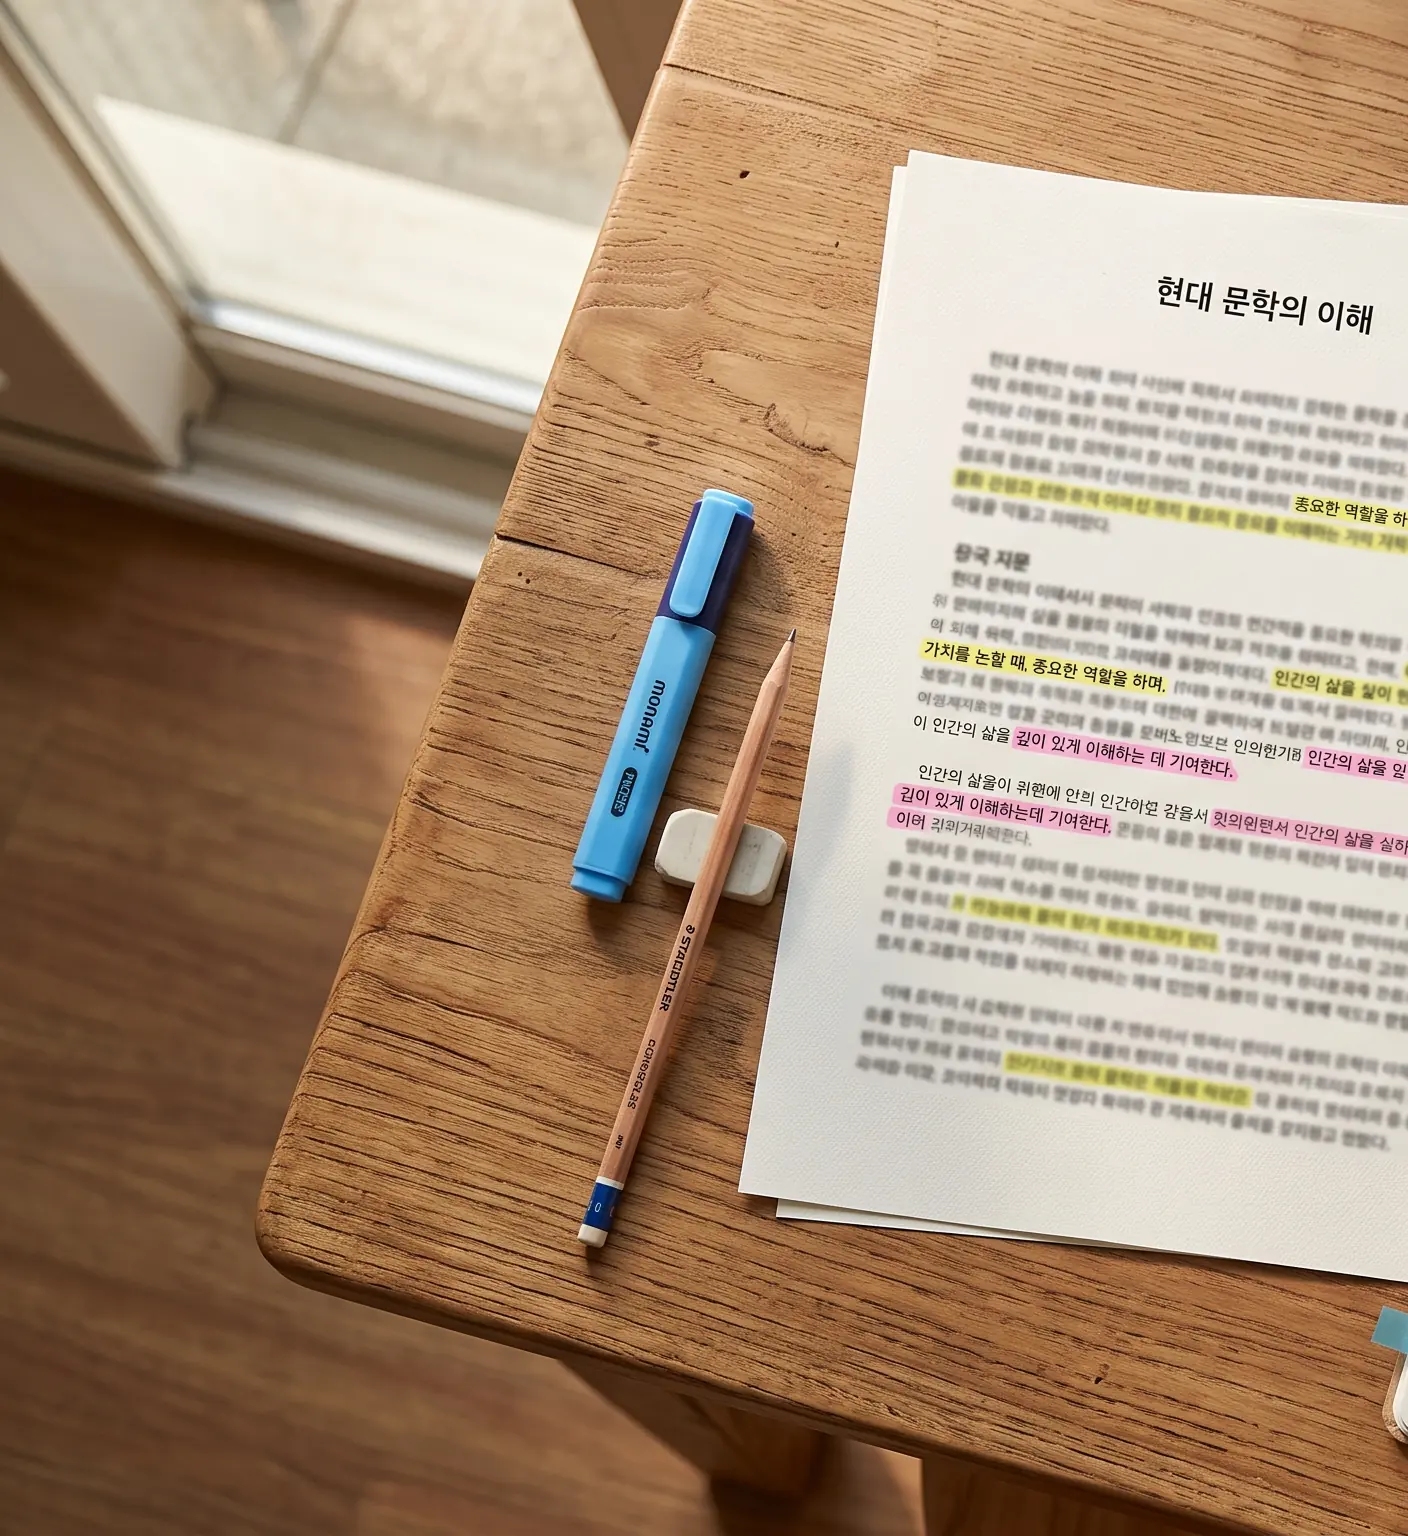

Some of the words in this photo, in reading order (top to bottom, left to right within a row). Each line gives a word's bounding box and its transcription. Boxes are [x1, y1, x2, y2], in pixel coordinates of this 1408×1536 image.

[1158, 276, 1213, 312] 현대
[1223, 286, 1307, 326] 문학의
[1318, 301, 1374, 335] 이해
[924, 641, 971, 662] 가치를
[1010, 655, 1028, 673] 때,
[634, 679, 666, 754] monami
[913, 715, 927, 731] 이
[932, 717, 977, 739] 인간의
[981, 725, 1011, 743] 삶을
[1086, 741, 1145, 765] 이해하는
[1151, 752, 1165, 767] 데
[1170, 754, 1233, 778] 기여한다.
[1308, 749, 1352, 771] 인간의
[1357, 757, 1387, 777] 삶을
[918, 764, 963, 786] 인간의
[934, 791, 964, 811] 있게
[1049, 809, 1111, 834] 기여한다.
[1294, 824, 1339, 844] 인간의
